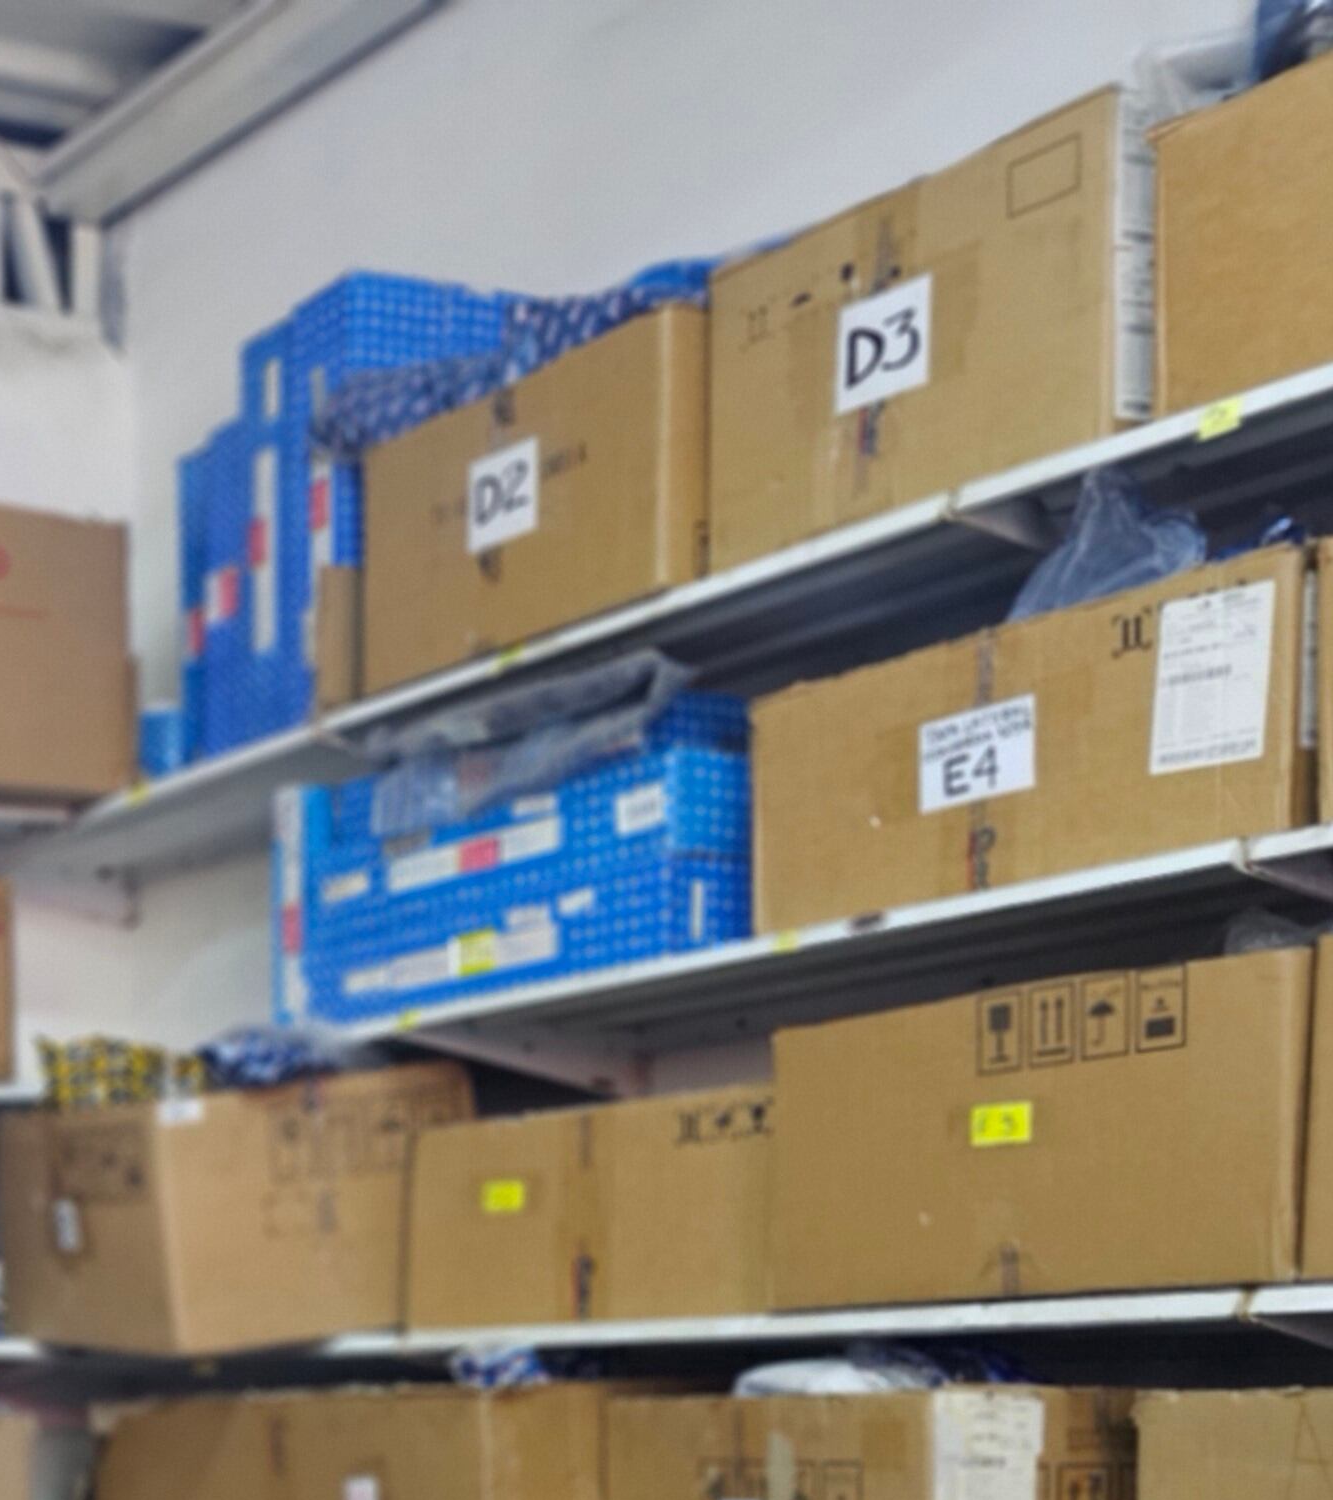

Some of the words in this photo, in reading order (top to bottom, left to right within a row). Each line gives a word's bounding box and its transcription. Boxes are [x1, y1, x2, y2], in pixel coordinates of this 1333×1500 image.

[843, 308, 920, 391] D3
[474, 459, 531, 530] D2
[942, 746, 999, 798] E4
